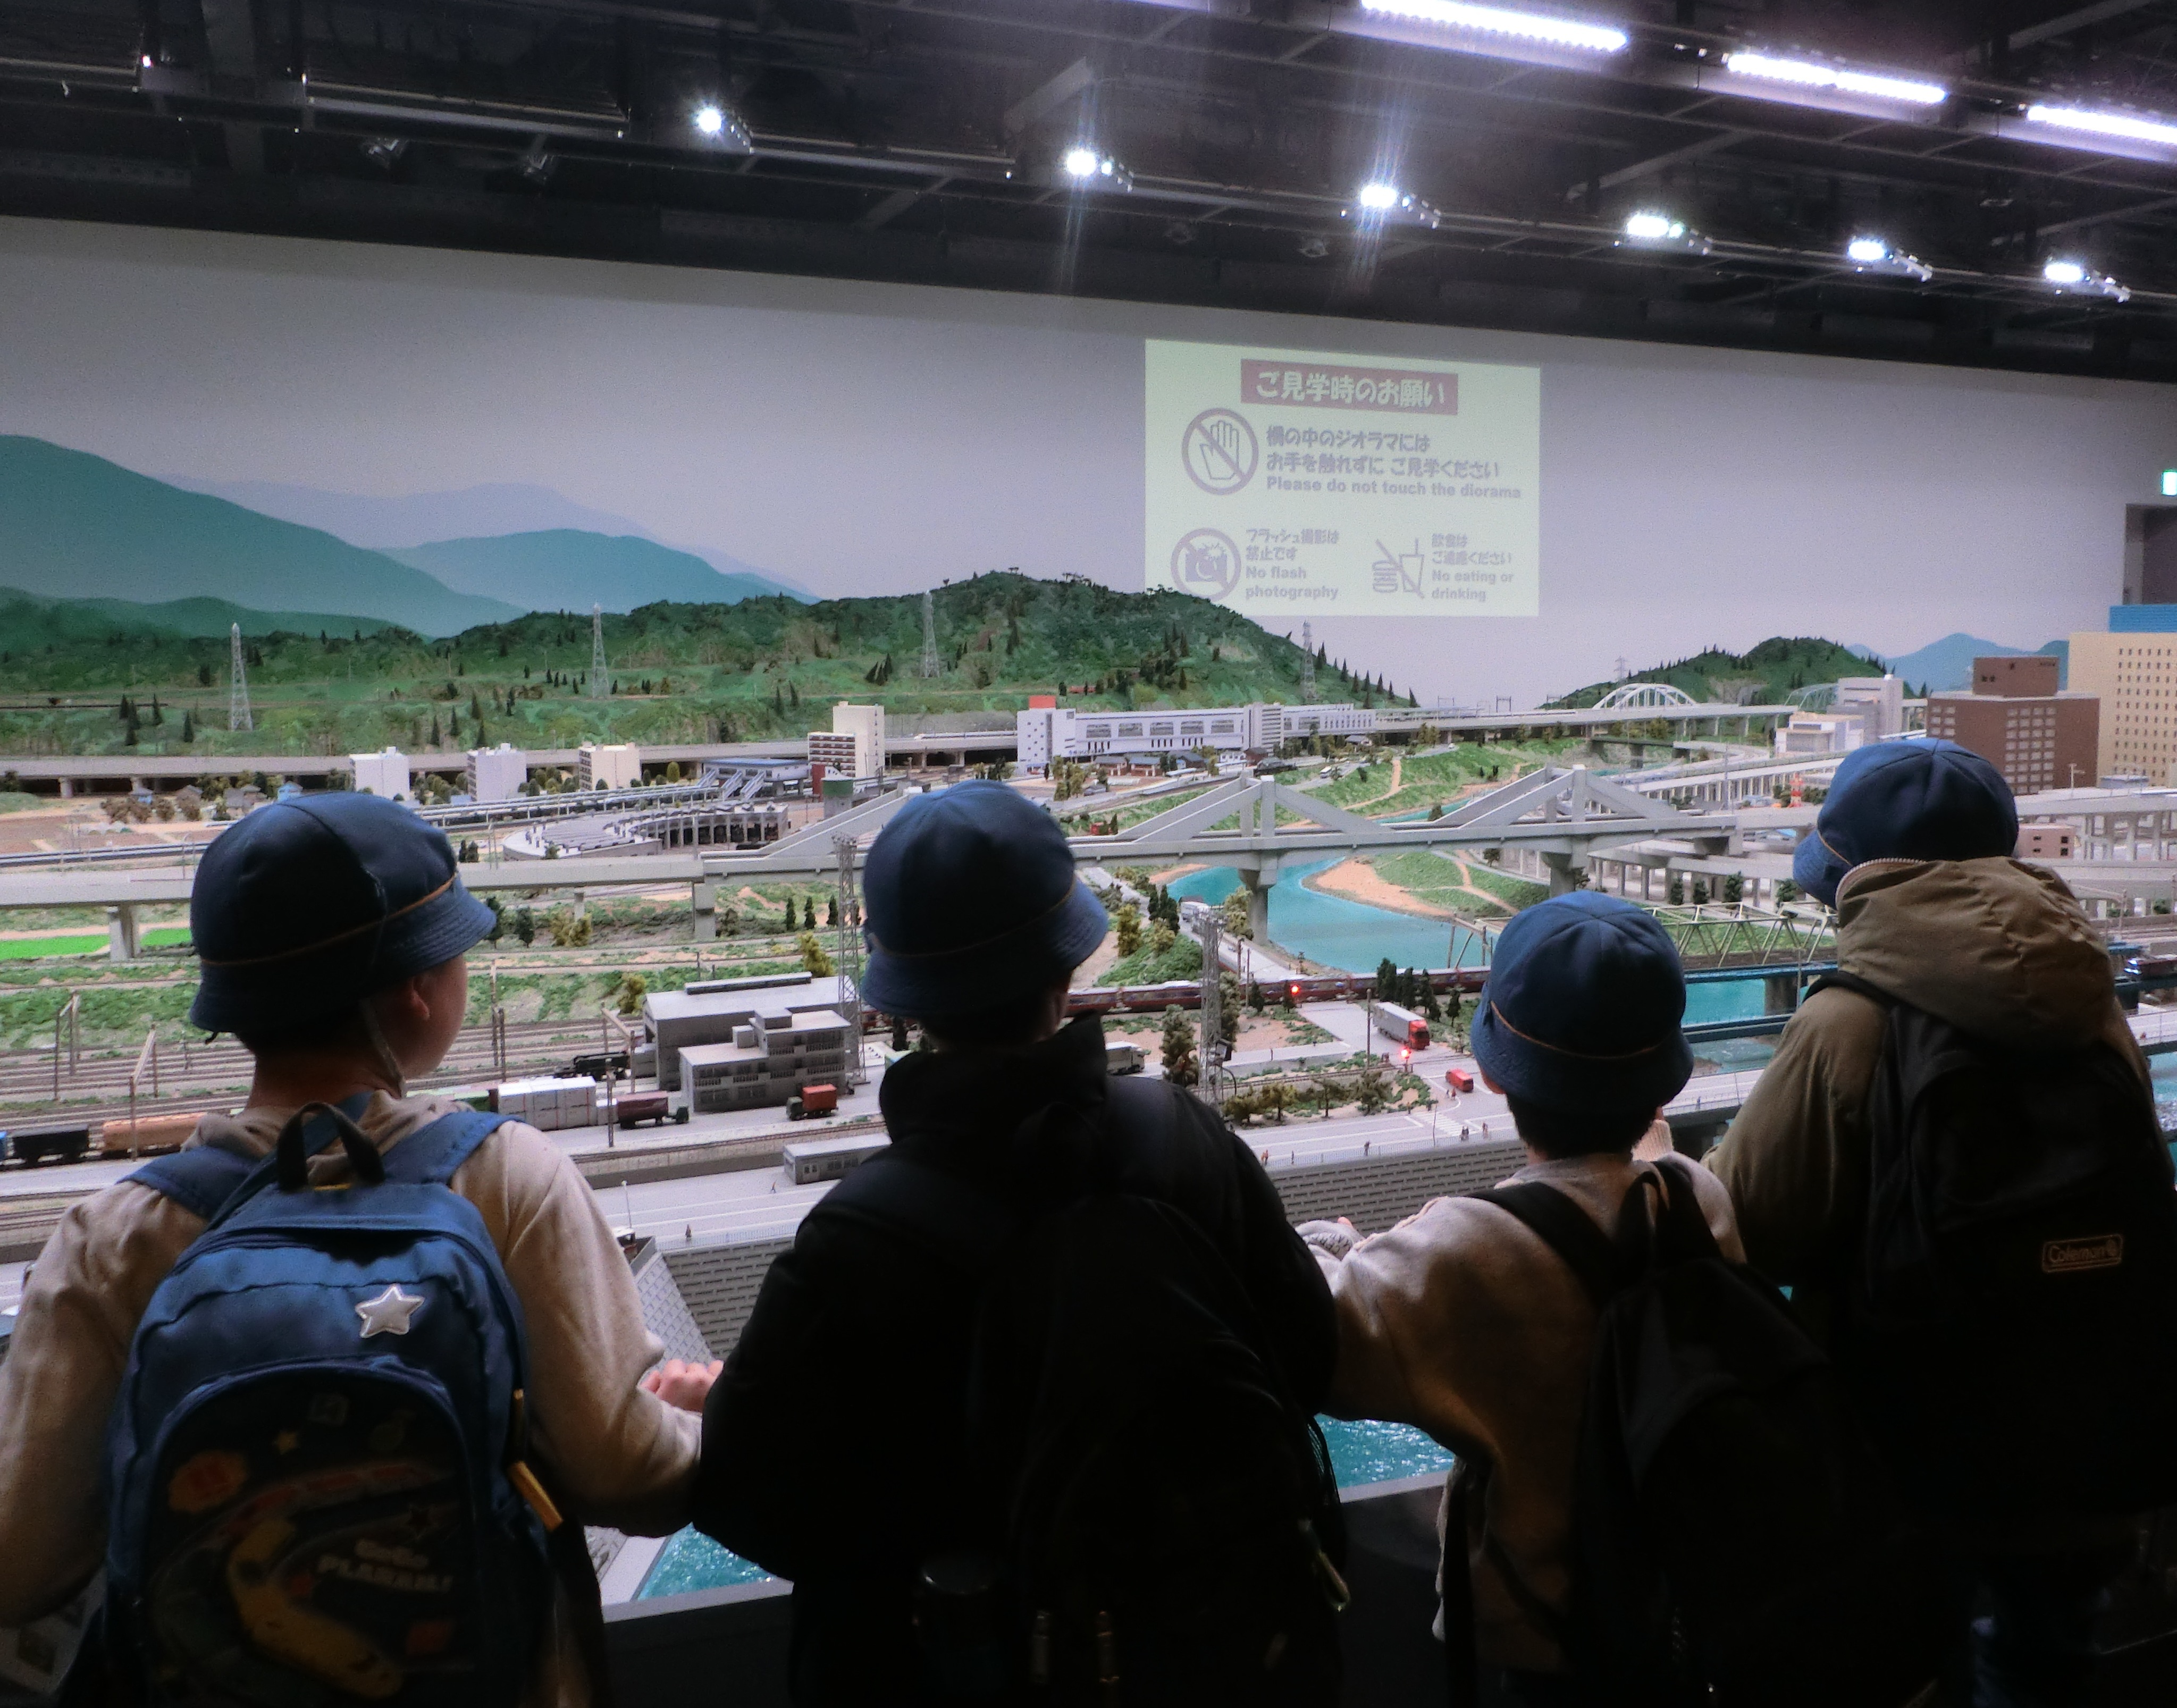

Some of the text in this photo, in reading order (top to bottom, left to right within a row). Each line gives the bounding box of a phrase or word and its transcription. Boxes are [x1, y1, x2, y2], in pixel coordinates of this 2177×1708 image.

[1256, 371, 1445, 408] ご見学時のお願い
[1266, 476, 1522, 499] Please do not touch the diorama
[1246, 545, 1298, 561] 禁止です
[1246, 566, 1307, 579] No flash
[1432, 569, 1515, 585] No eating or
[1245, 585, 1339, 601] photography
[1431, 587, 1487, 603] drinking
